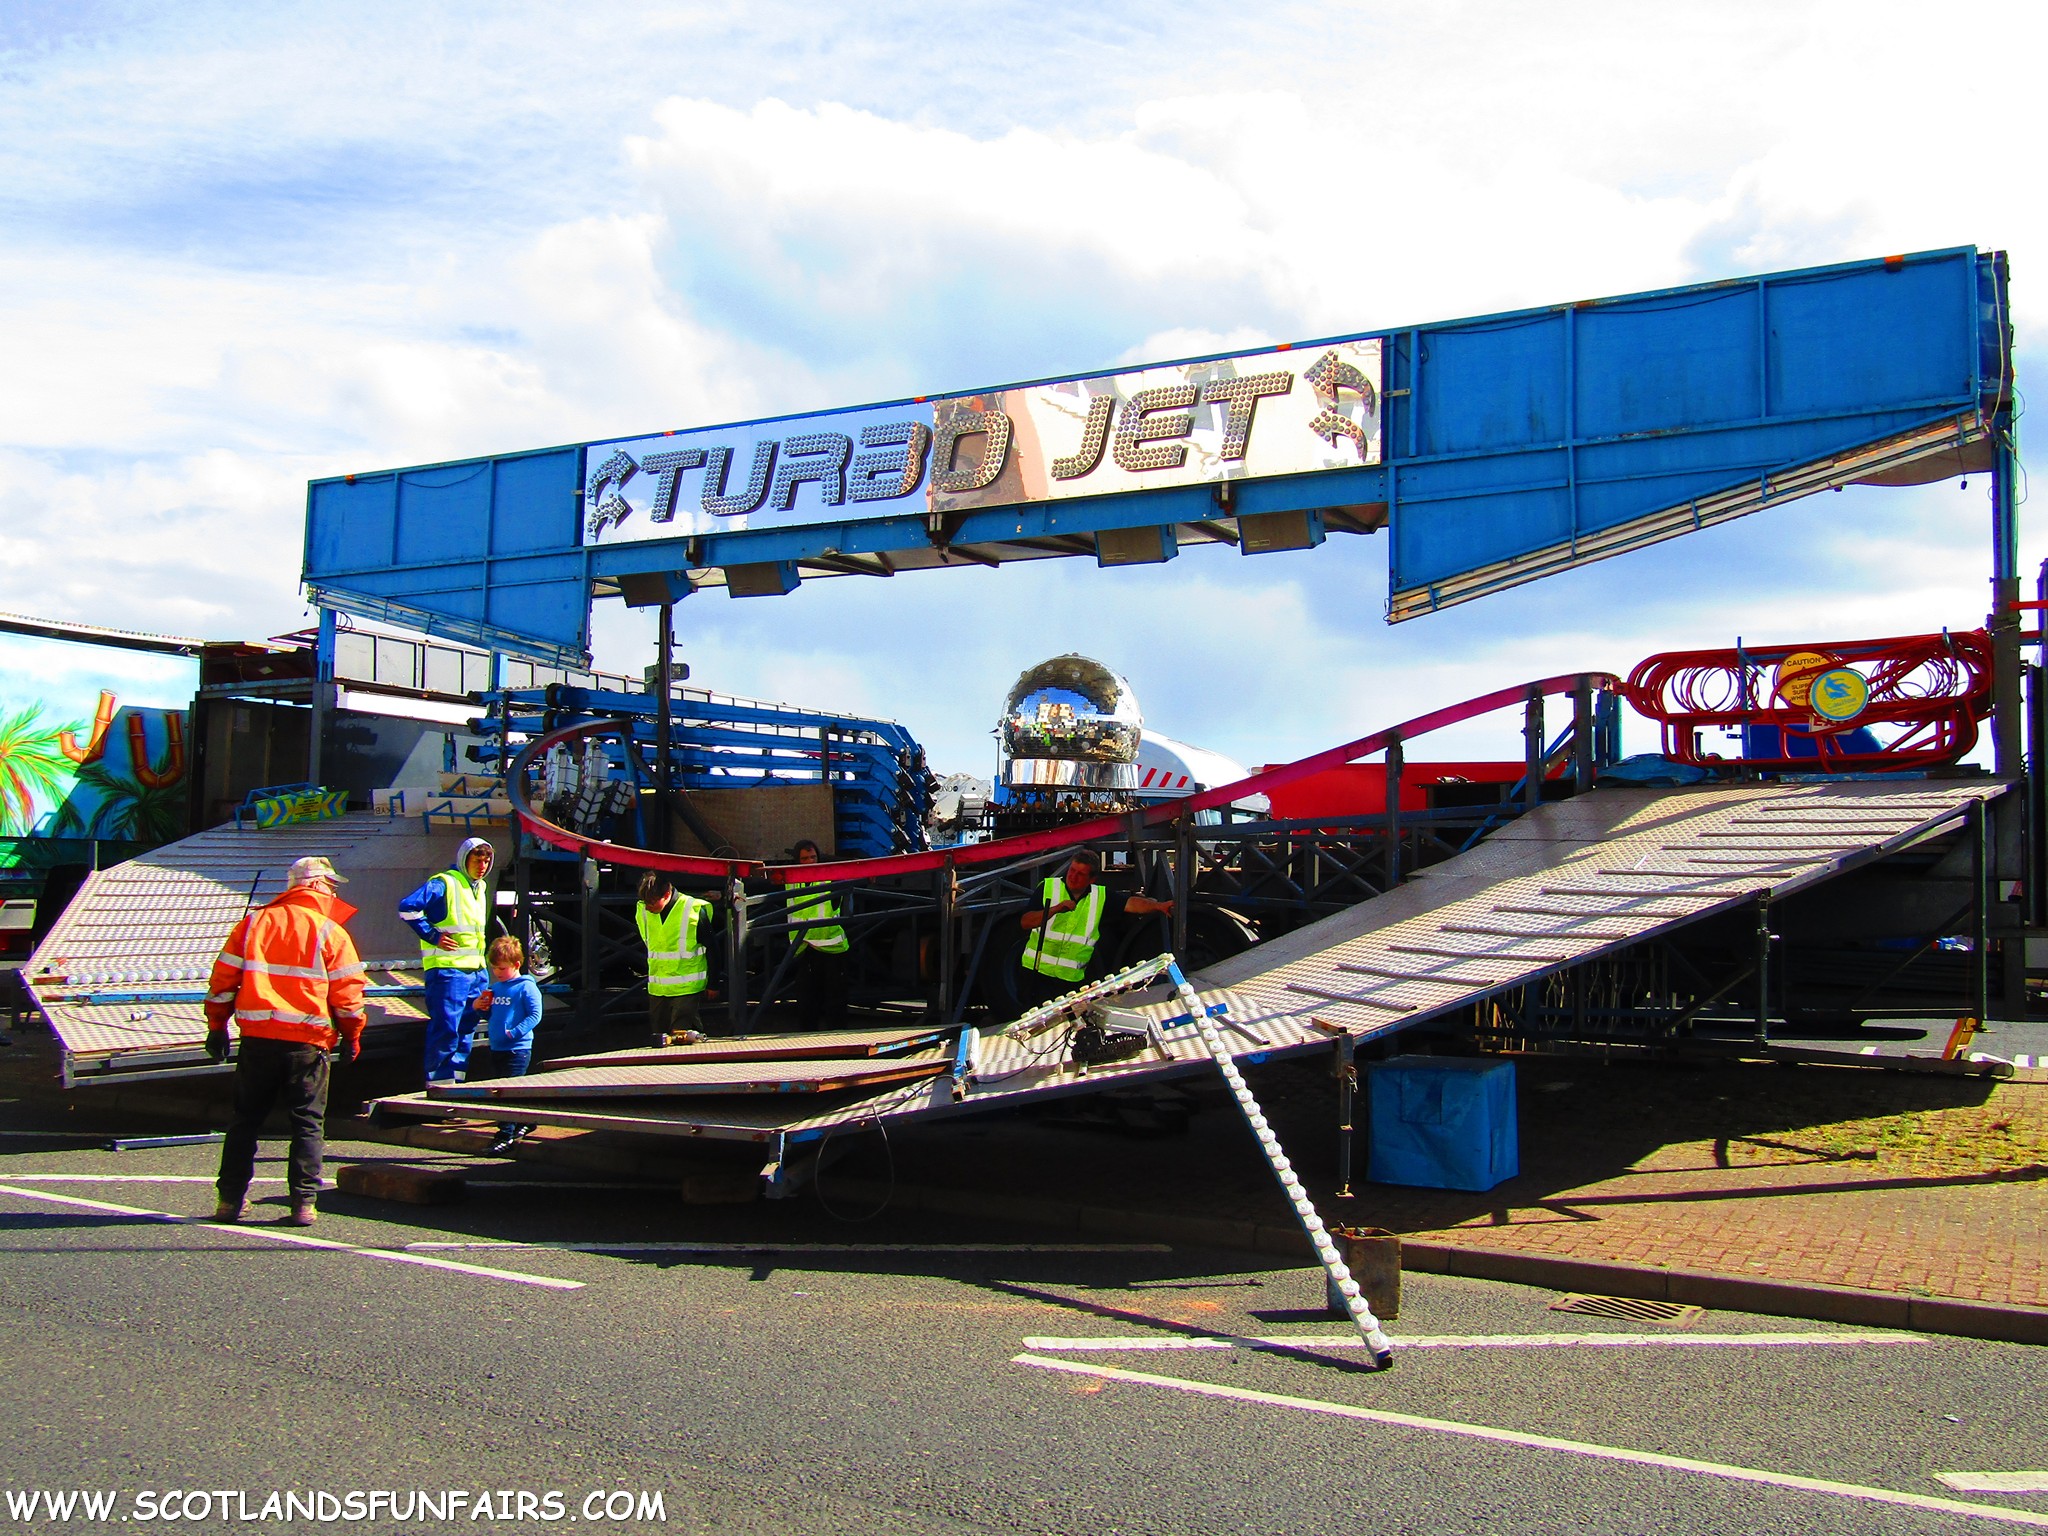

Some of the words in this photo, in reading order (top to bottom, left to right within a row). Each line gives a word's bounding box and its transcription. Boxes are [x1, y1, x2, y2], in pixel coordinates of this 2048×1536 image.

[640, 409, 1014, 523] TURBO
[1050, 370, 1297, 482] JET
[1786, 657, 1821, 667] CAUTION
